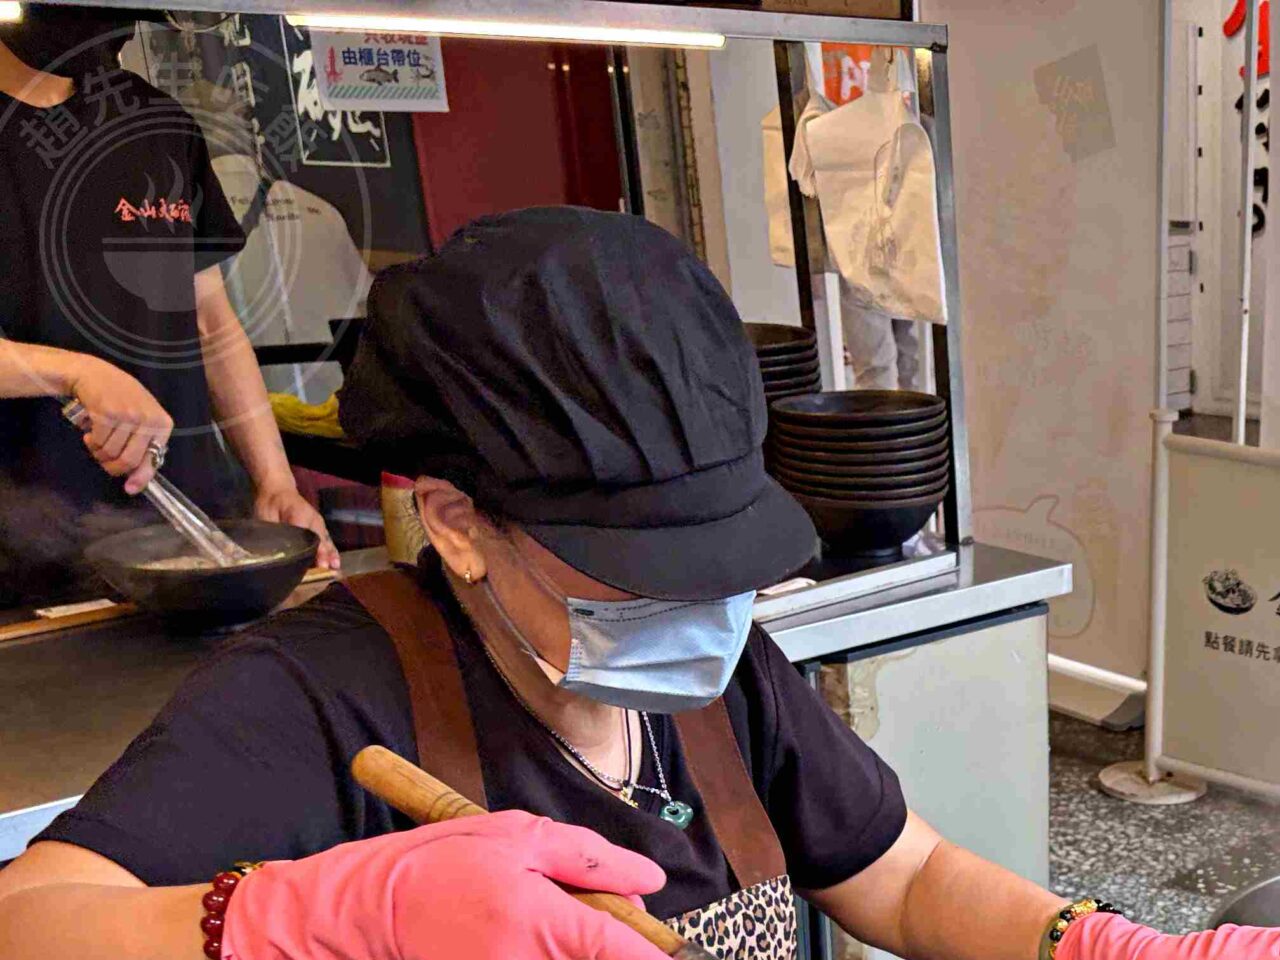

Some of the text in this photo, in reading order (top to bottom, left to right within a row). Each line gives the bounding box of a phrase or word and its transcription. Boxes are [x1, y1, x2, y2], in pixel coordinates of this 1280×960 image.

[341, 47, 421, 67] 由櫃台帶位
